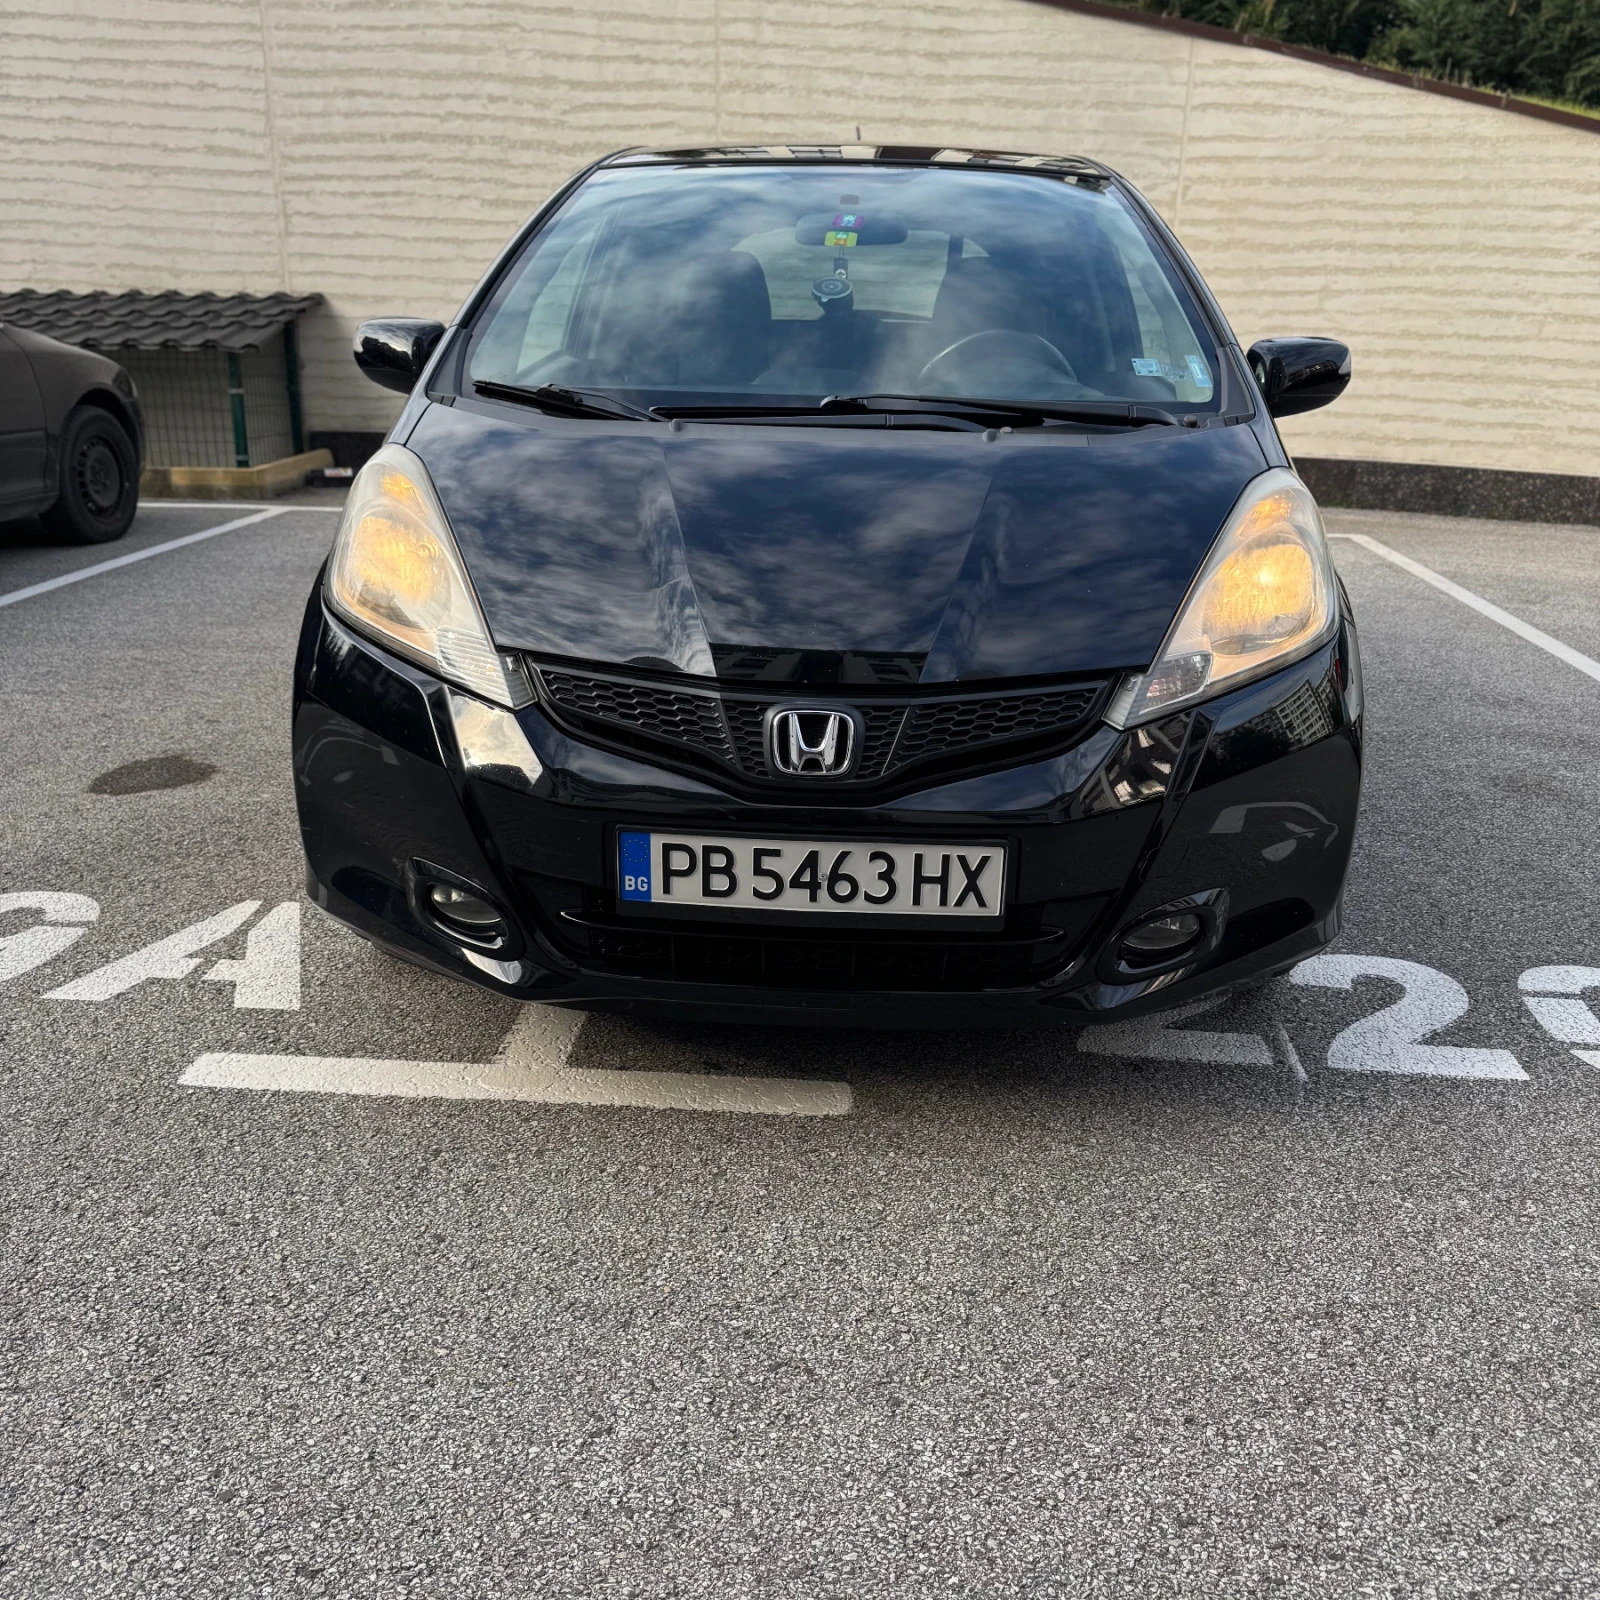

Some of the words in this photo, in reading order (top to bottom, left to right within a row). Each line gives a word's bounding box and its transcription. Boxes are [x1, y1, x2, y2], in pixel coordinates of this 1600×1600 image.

[625, 875, 648, 891] BG
[661, 842, 738, 898] PB
[752, 848, 897, 904] 5463
[911, 853, 992, 907] HX
